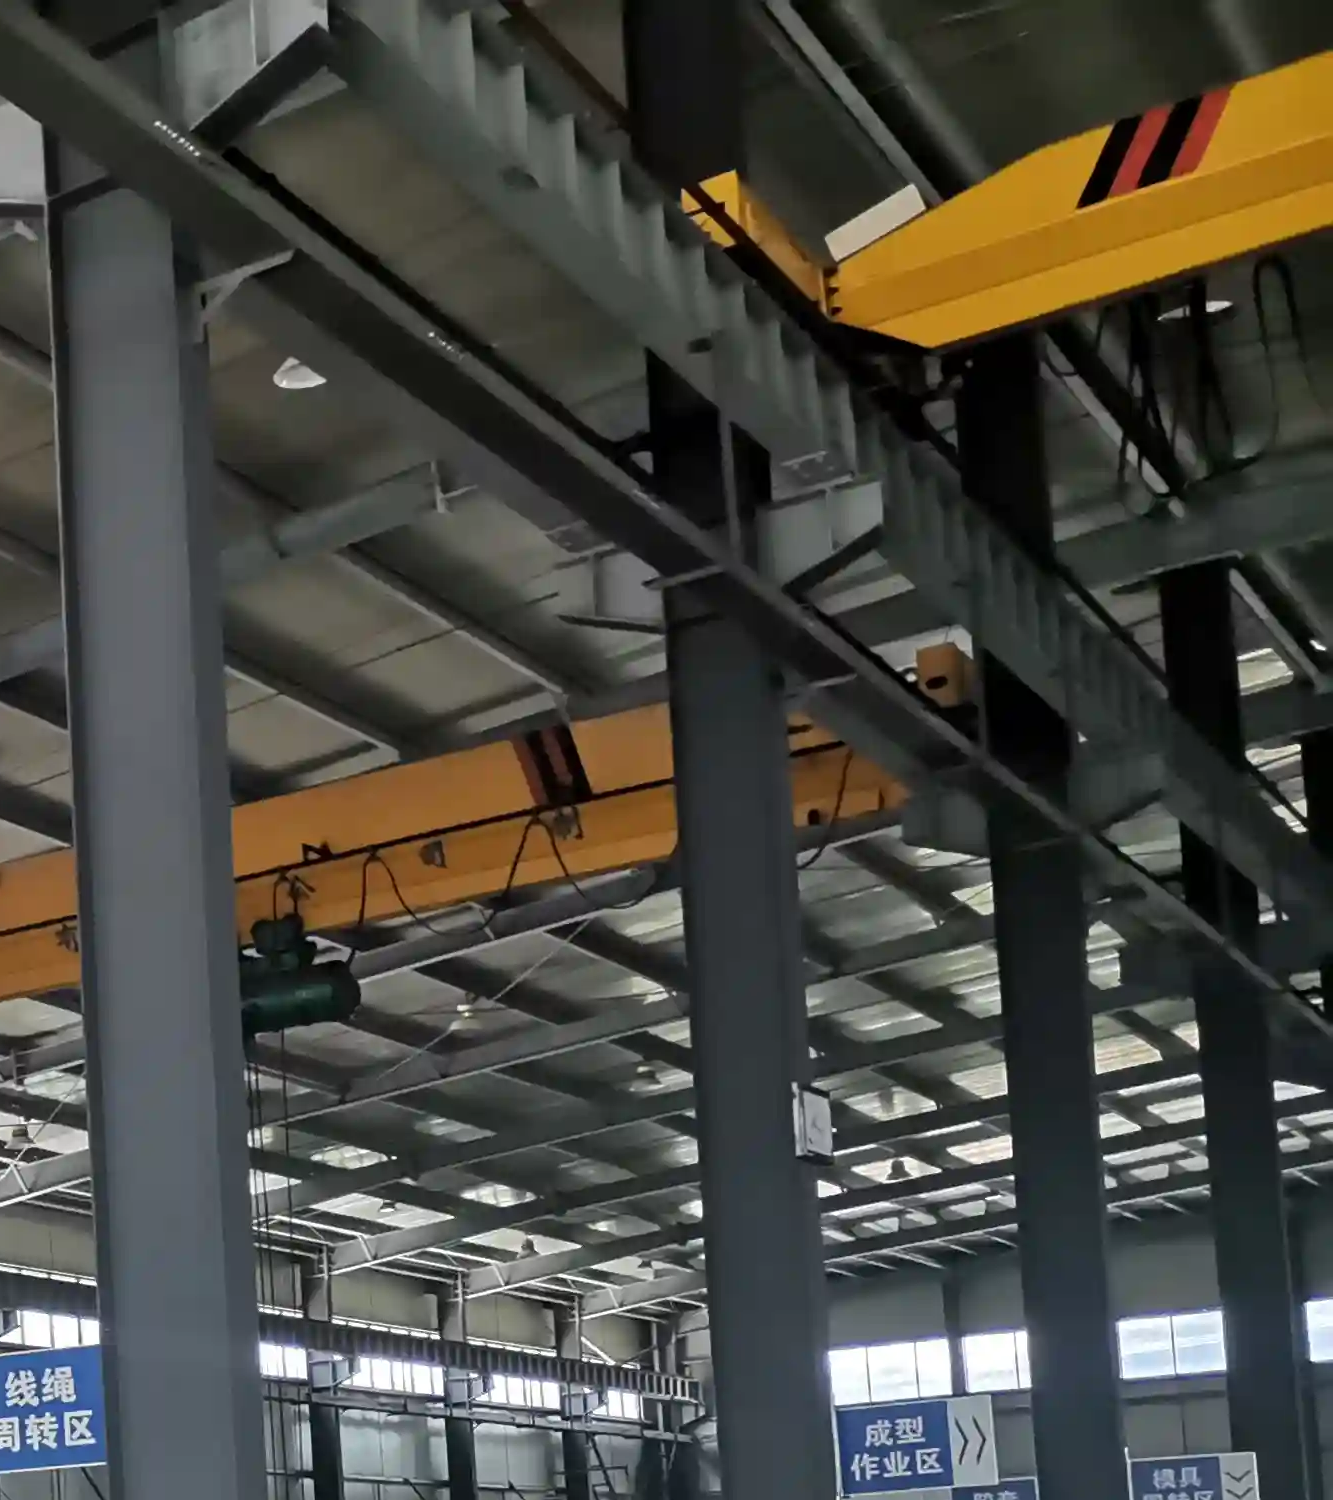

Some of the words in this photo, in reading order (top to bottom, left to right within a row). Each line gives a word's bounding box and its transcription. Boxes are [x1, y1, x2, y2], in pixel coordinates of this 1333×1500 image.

[5, 1366, 76, 1407] 线绳
[864, 1415, 926, 1447] 成型
[850, 1447, 944, 1481] 作业区
[1152, 1466, 1202, 1491] 模具
